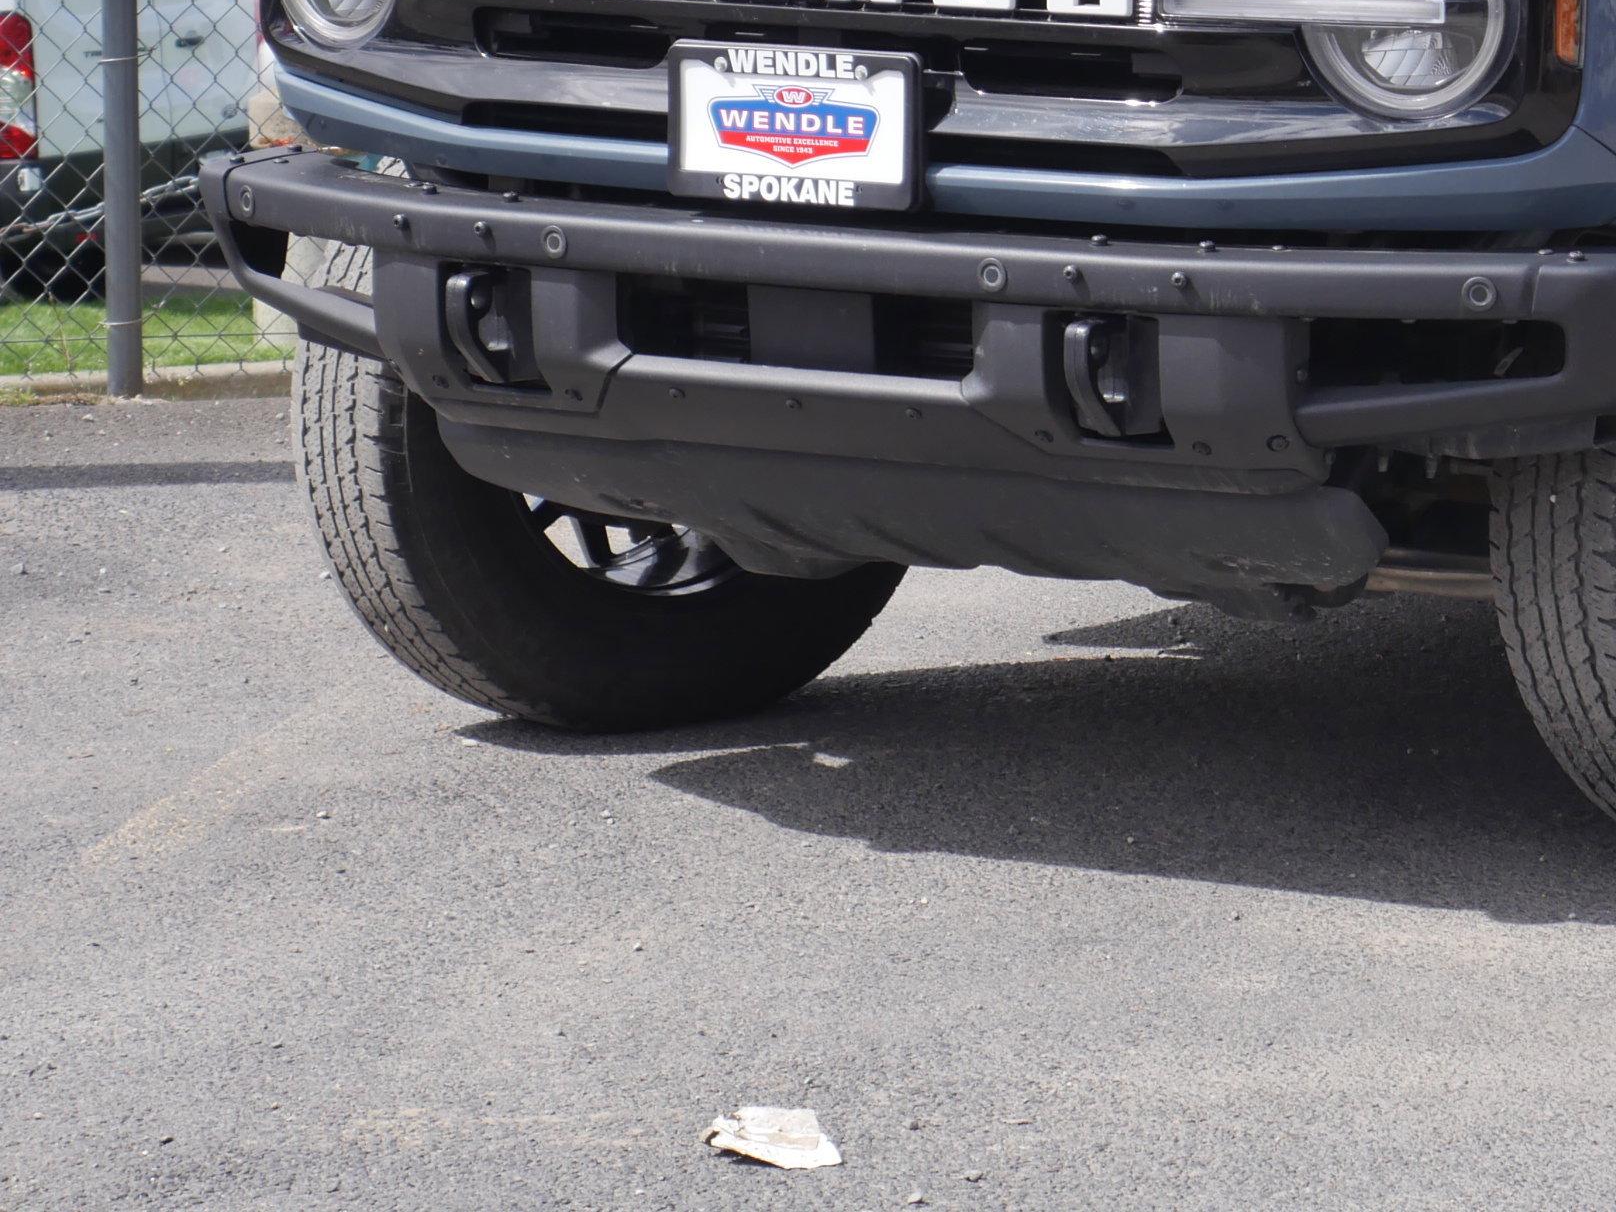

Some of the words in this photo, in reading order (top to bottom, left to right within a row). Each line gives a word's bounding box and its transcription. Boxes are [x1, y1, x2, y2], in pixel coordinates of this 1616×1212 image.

[728, 48, 855, 79] WENDLE
[719, 109, 865, 135] WENDLE
[746, 135, 792, 145] AUTOMOTIVE
[793, 137, 839, 147] EXCELLENCE
[772, 145, 795, 153] SINCE
[722, 173, 856, 207] SPOKANE
